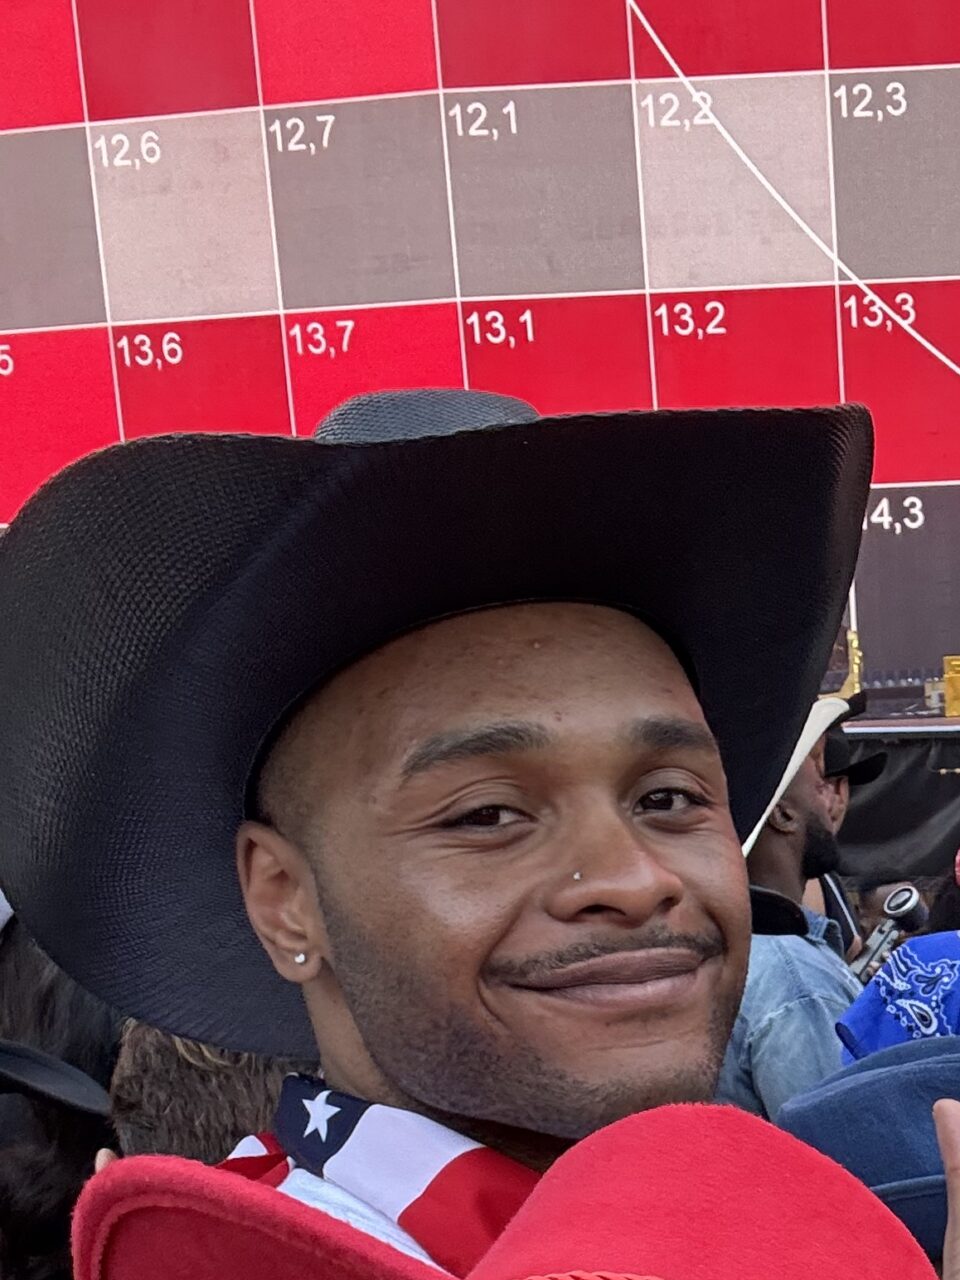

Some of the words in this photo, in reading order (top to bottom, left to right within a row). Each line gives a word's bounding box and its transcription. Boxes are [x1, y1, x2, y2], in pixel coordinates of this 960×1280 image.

[448, 100, 517, 141] 12,1
[640, 90, 714, 128] 12,2
[833, 81, 907, 122] 12,3
[94, 131, 161, 170] 12,6
[269, 114, 335, 155] 12,7
[466, 309, 534, 348] 13,1
[654, 301, 726, 339] 13,2
[843, 292, 917, 330] 13,3
[117, 332, 183, 371] 13,6
[289, 320, 355, 359] 13,7
[862, 496, 925, 535] 4,3
